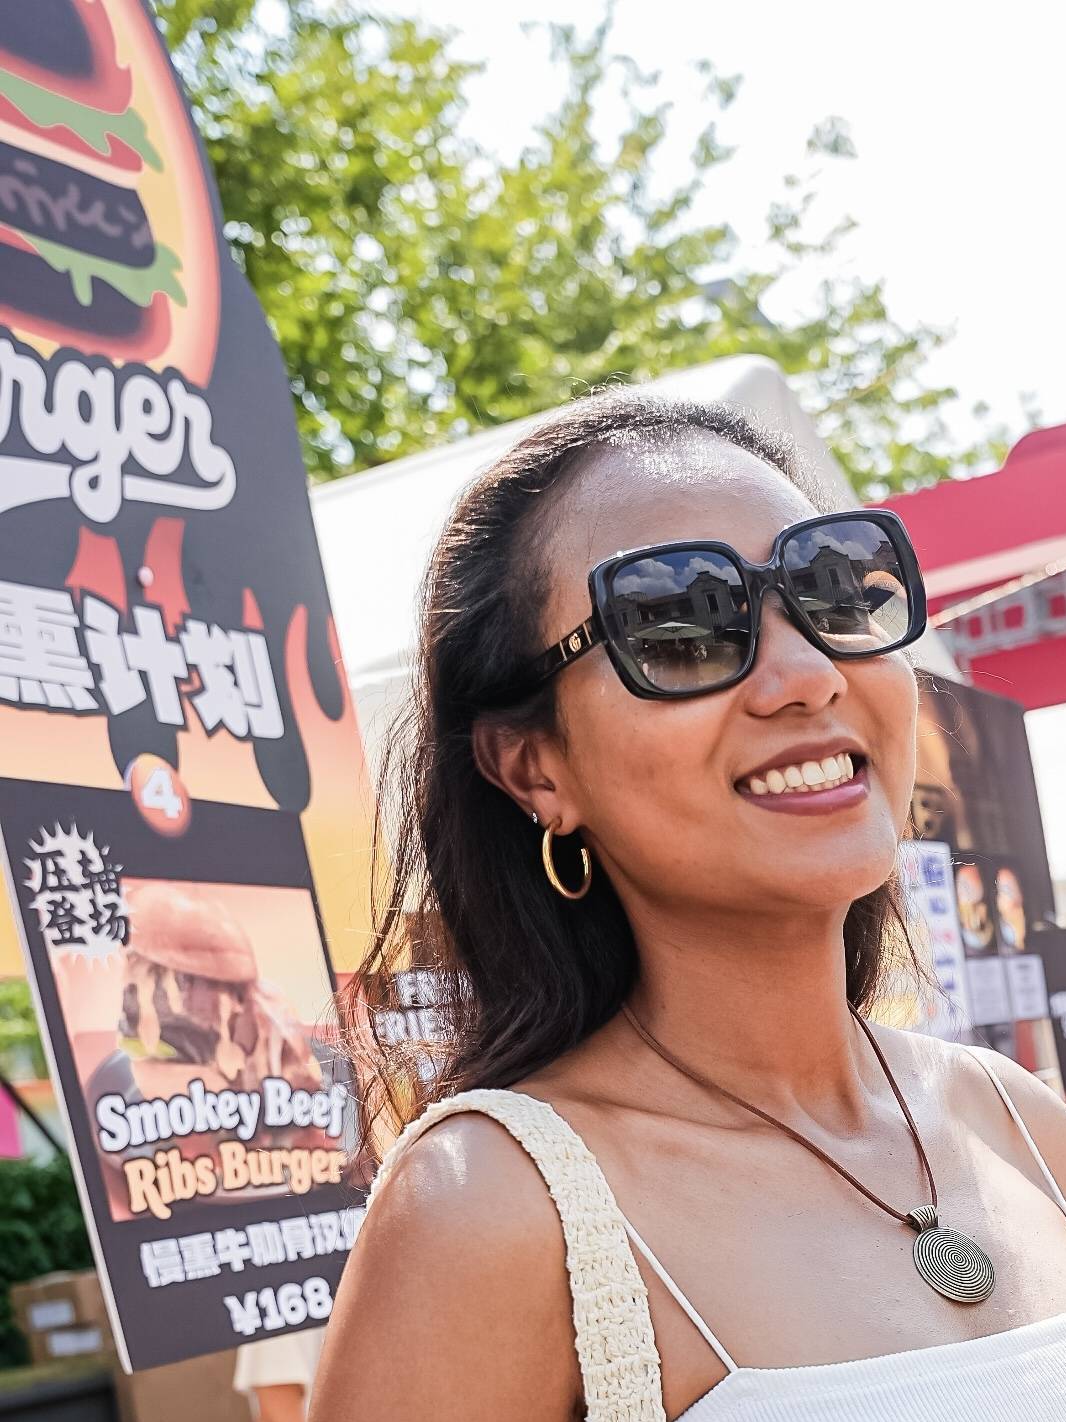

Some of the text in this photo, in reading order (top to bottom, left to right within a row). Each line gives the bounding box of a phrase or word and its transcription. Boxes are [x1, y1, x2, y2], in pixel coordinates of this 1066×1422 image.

[140, 767, 183, 820] 4
[46, 893, 130, 946] 登场
[96, 1076, 348, 1152] Smokey Beef
[123, 1140, 347, 1220] Ribs Burger
[223, 1276, 334, 1336] ¥168
